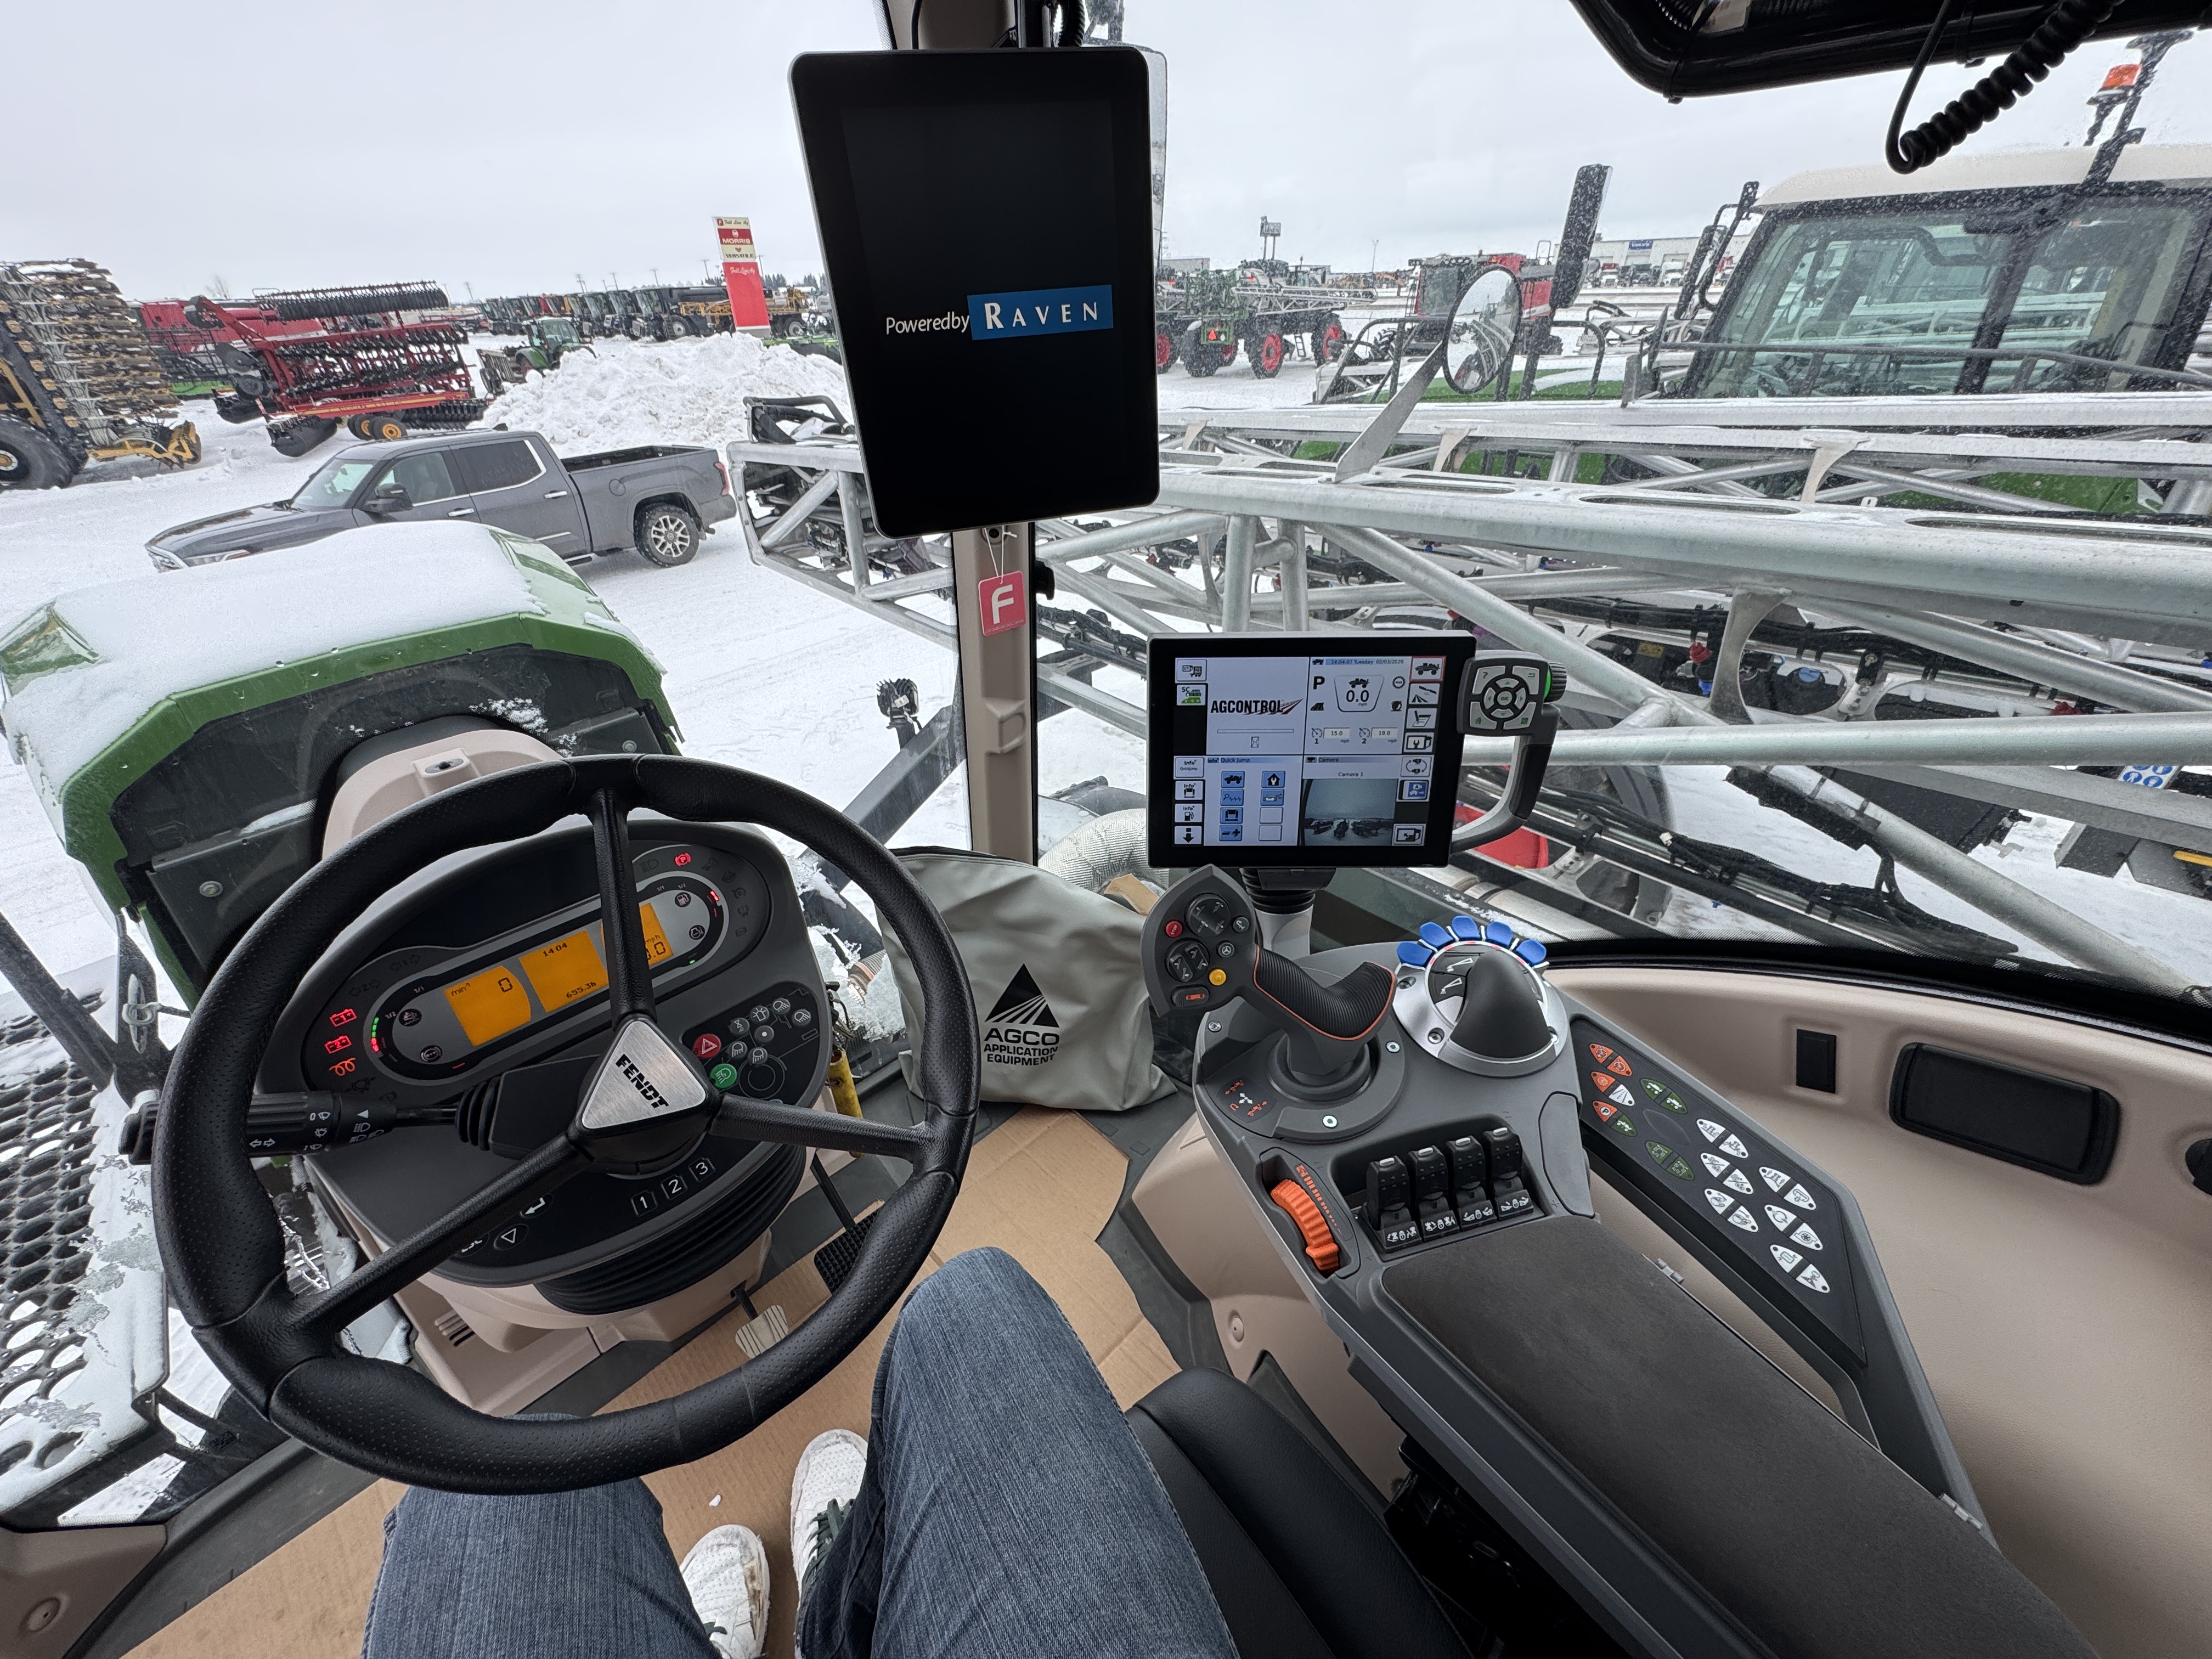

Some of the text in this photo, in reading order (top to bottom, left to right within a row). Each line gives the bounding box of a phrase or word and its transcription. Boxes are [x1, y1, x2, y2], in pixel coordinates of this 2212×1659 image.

[984, 302, 1098, 330] RAVEN
[1313, 676, 1325, 690] P
[1346, 690, 1369, 702] 0.0
[1210, 699, 1284, 714] AGCONTROL
[645, 934, 660, 944] mph
[498, 977, 514, 993] 0
[984, 1028, 1060, 1046] AGCO
[984, 1043, 1058, 1057] APPLICATION
[988, 1053, 1055, 1066] EQUIPMENT
[615, 1053, 670, 1109] FENDT
[695, 1161, 709, 1175] 3
[668, 1178, 682, 1194] 2
[640, 1195, 648, 1209] 1
